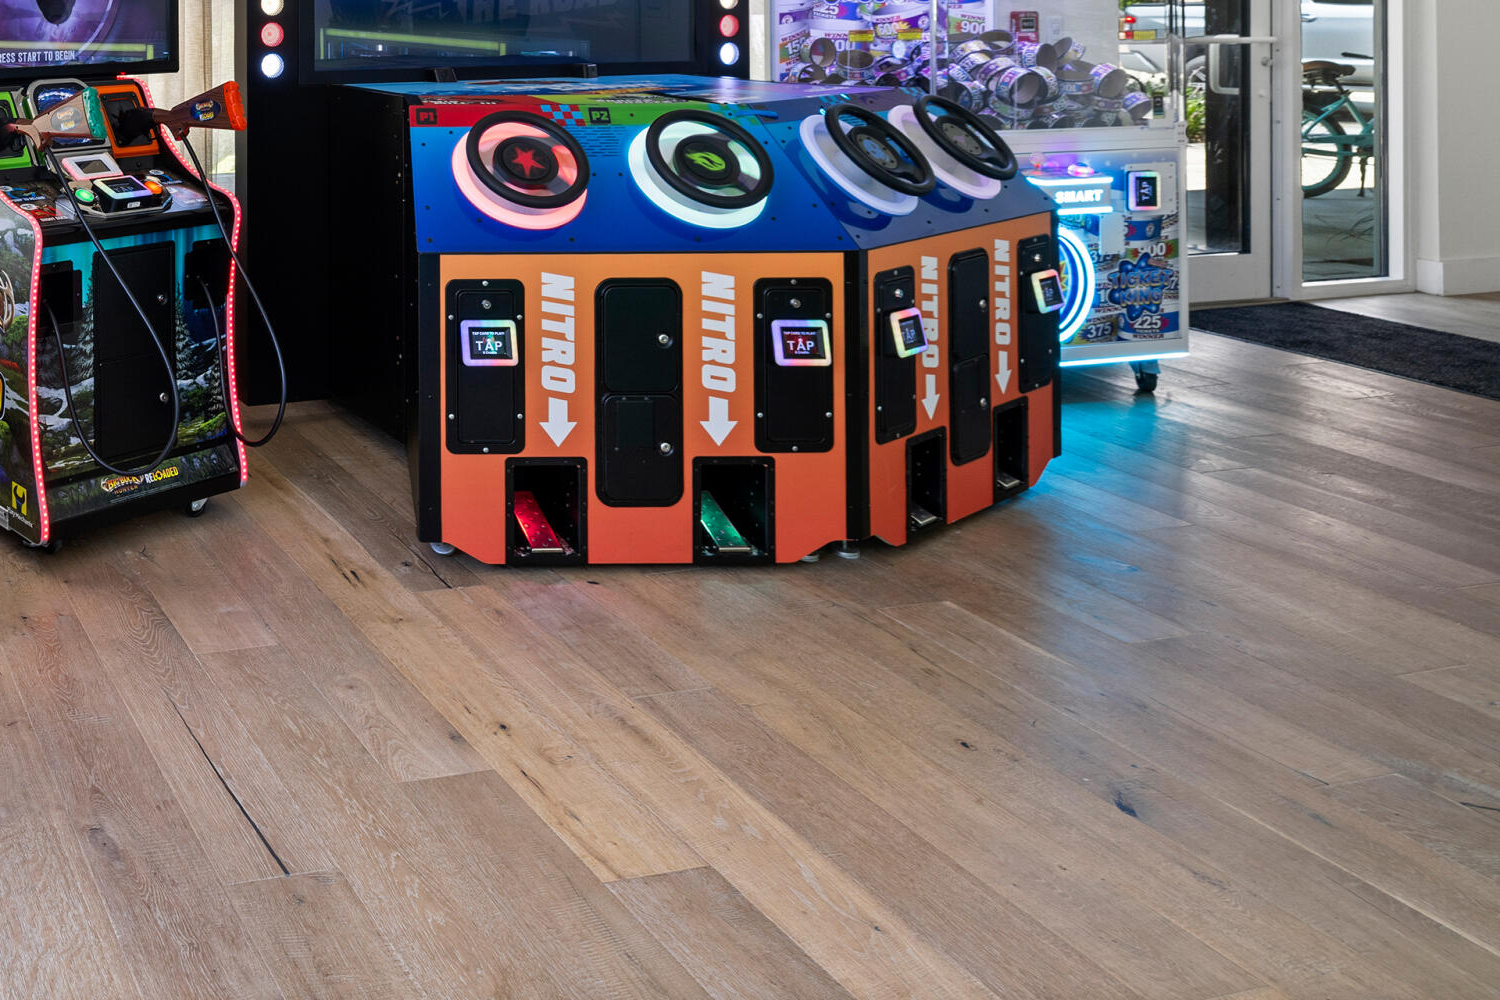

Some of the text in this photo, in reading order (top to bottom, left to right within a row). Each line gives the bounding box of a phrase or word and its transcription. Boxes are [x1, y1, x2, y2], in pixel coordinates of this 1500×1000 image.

[17, 51, 42, 63] START
[43, 50, 53, 61] TO
[55, 50, 75, 61] BEGIN
[419, 110, 434, 122] P1
[591, 110, 608, 122] P2
[1055, 189, 1103, 204] SMART
[1108, 268, 1174, 288] TICKET
[994, 239, 1011, 345] NITRO
[1120, 287, 1163, 307] KING
[1133, 315, 1162, 329] 225
[541, 272, 575, 394] NITRO
[701, 271, 736, 393] NITRO
[1087, 322, 1112, 338] 375
[475, 338, 502, 351] TAP
[786, 338, 815, 351] TAP
[145, 466, 179, 483] RELOADED
